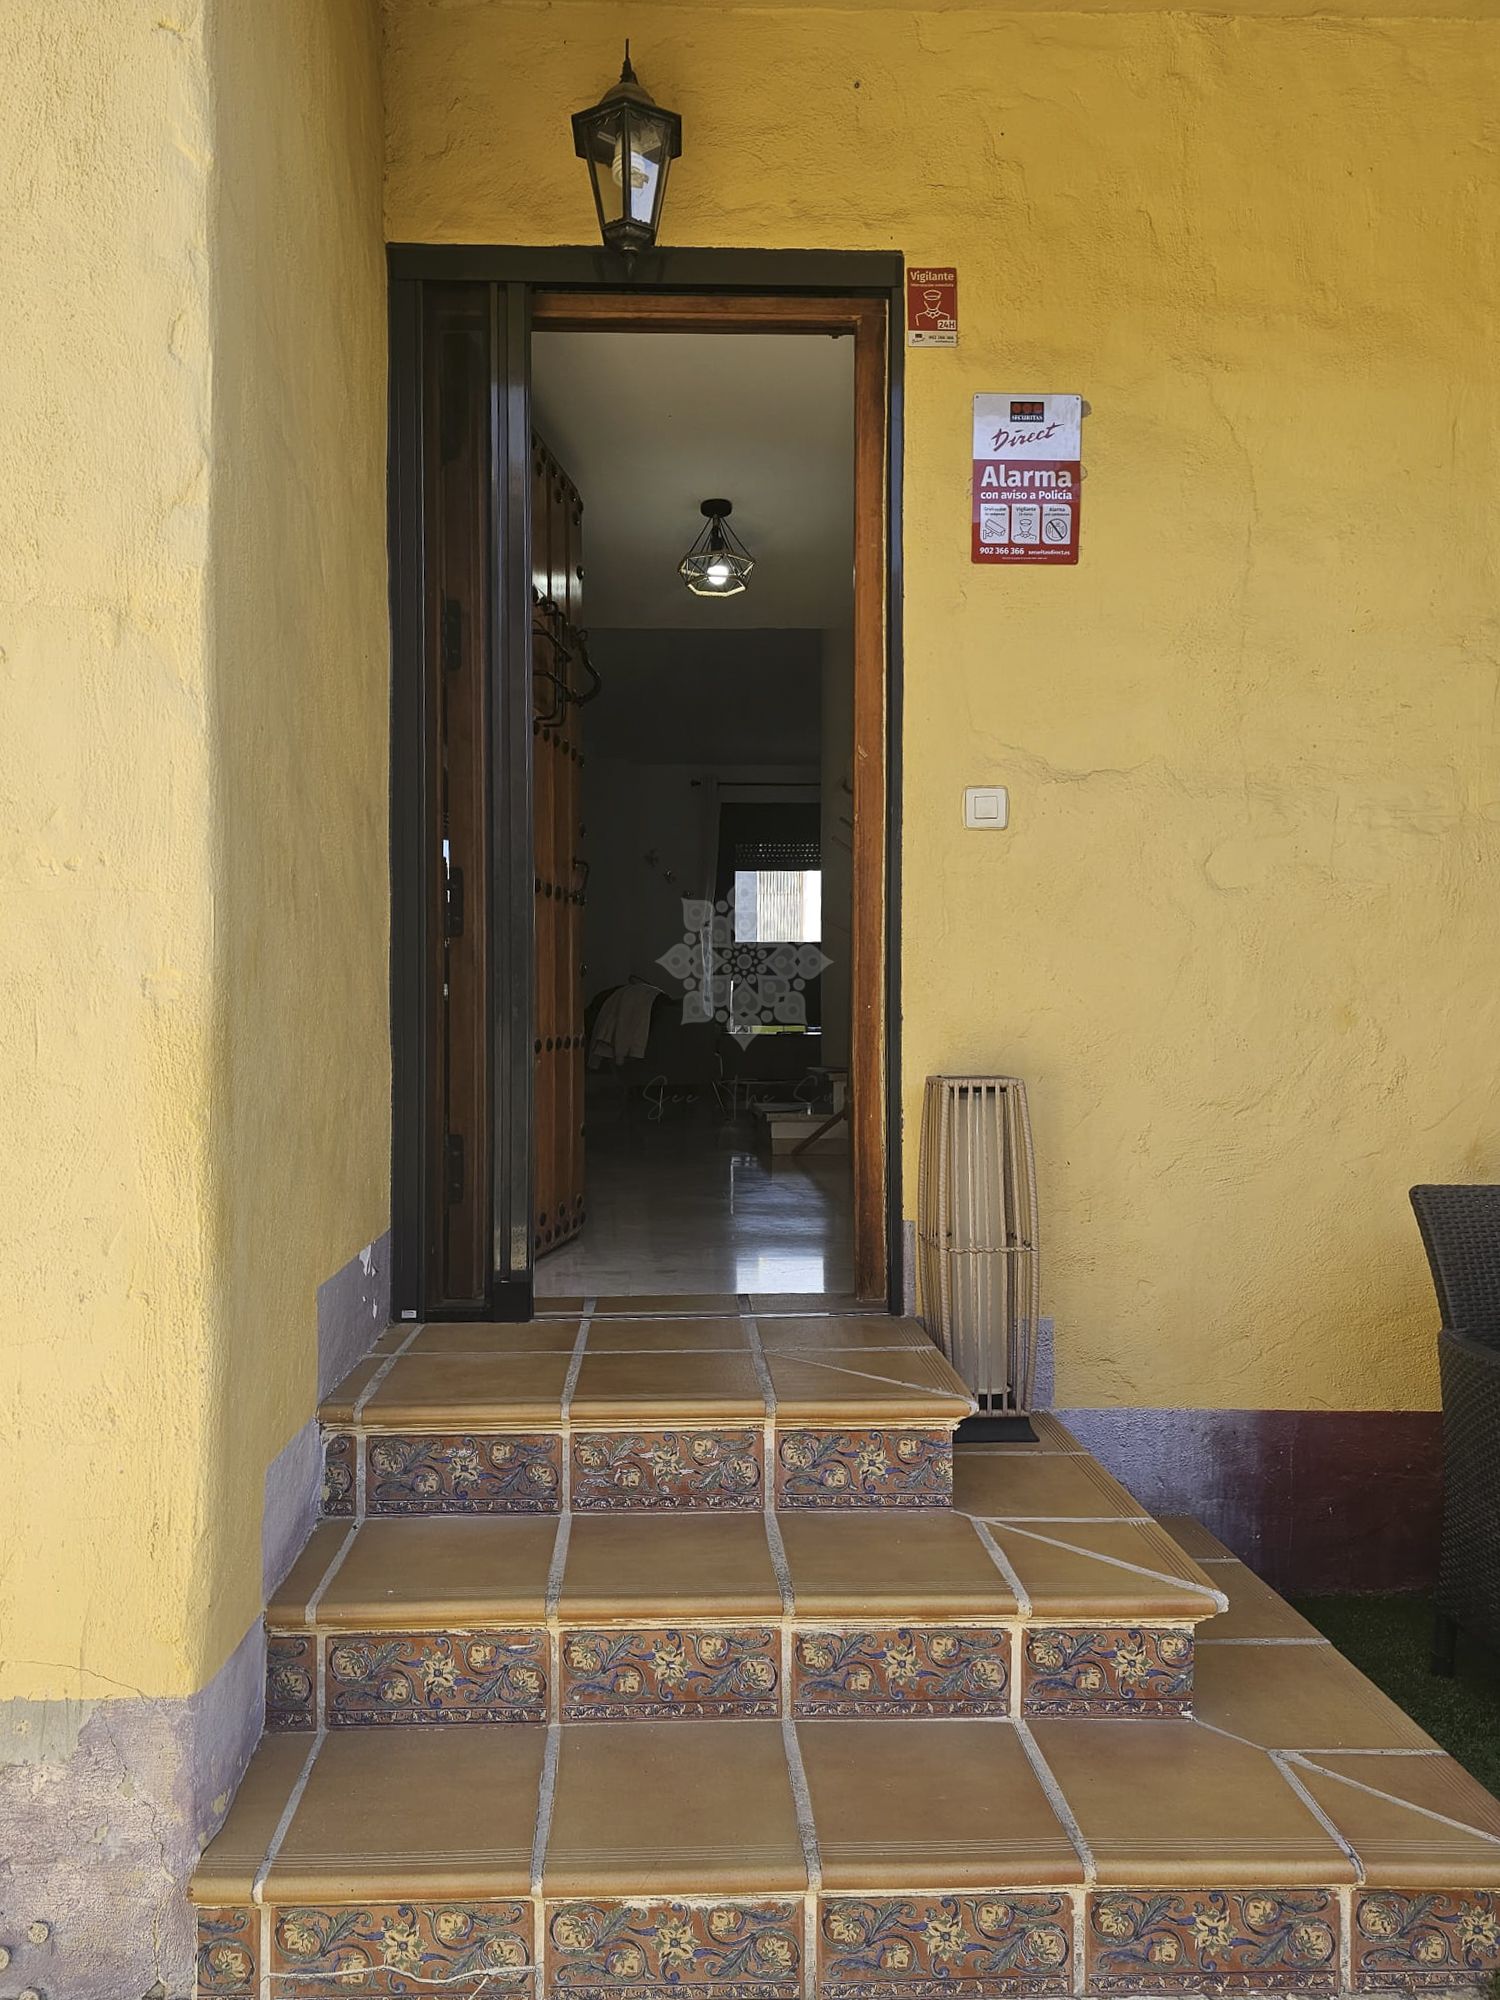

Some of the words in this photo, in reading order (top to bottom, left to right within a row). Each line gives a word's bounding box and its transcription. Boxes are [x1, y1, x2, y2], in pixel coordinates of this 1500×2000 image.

[910, 270, 955, 282] Vigilante
[938, 321, 955, 329] 24H
[991, 422, 1064, 452] Direct
[980, 464, 1072, 488] Alarma
[980, 491, 999, 500] con
[1001, 489, 1027, 500] aviso
[1029, 492, 1036, 500] a
[1038, 489, 1072, 500] Policía
[979, 546, 994, 555] 902
[995, 547, 1009, 555] 366
[1010, 547, 1025, 555] 366
